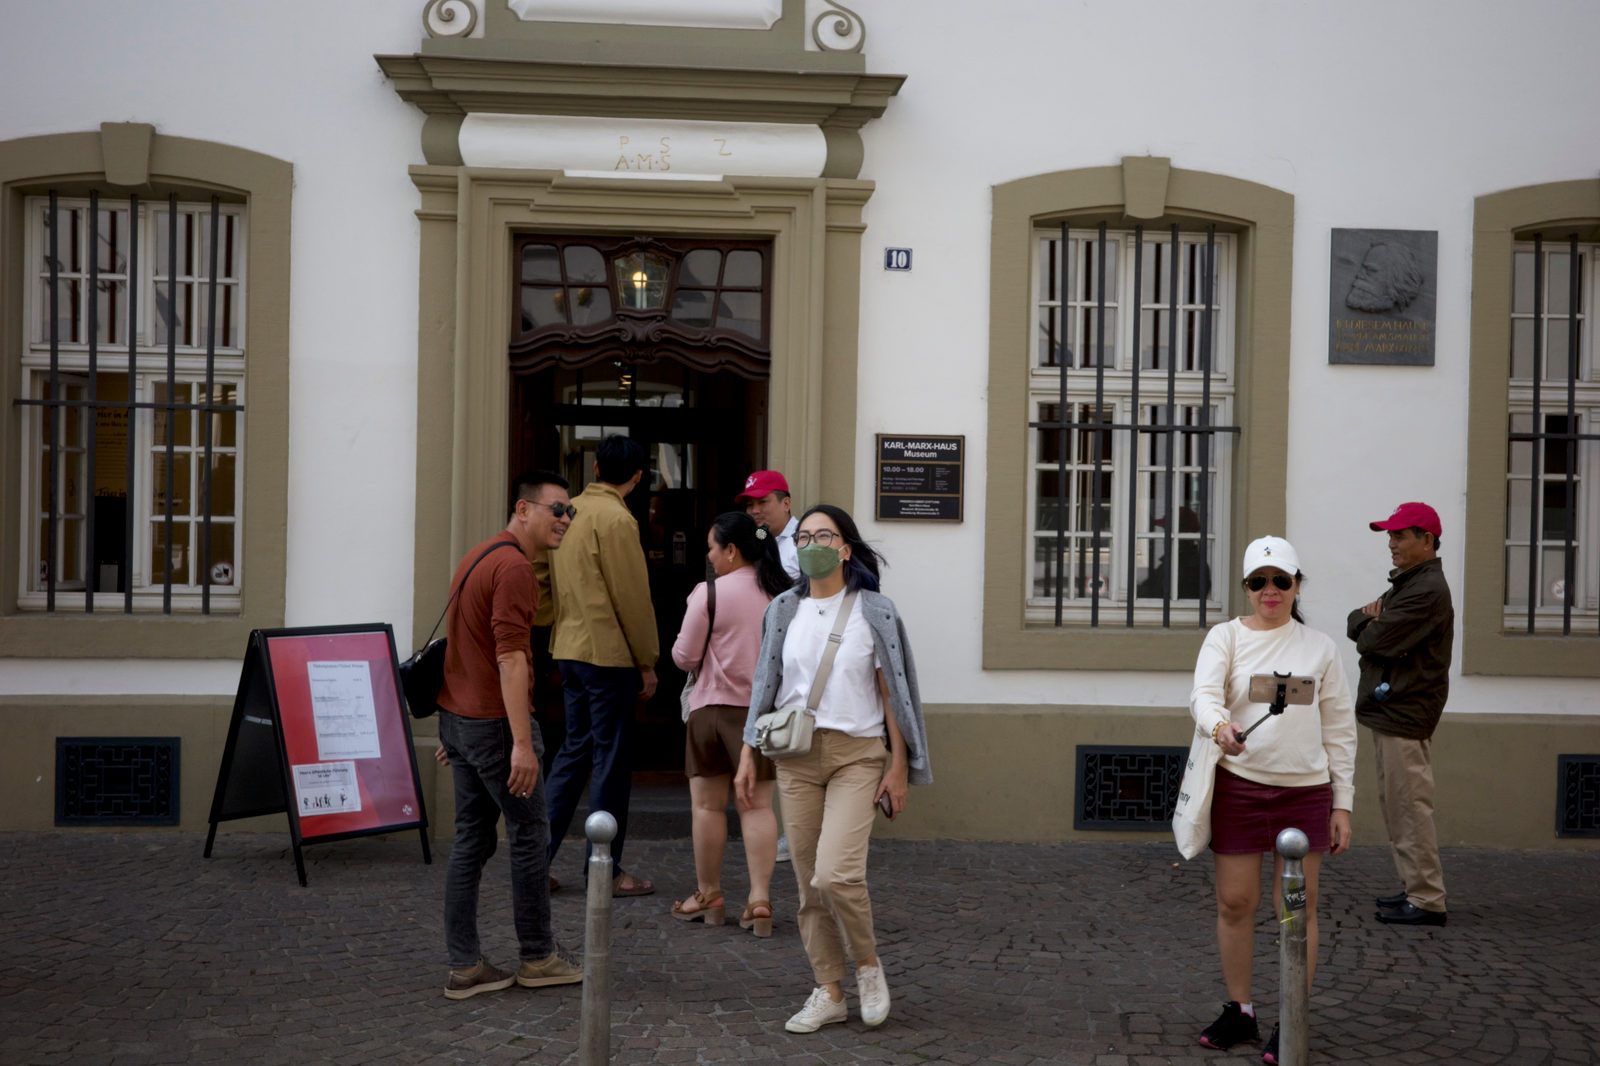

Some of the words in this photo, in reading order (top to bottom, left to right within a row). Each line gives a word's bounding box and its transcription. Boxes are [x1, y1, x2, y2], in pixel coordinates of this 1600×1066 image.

[619, 135, 629, 150] P
[660, 136, 671, 154] S
[890, 250, 907, 268] 10
[884, 441, 957, 451] KARL-MARX-HAUS
[903, 450, 938, 458] Museum
